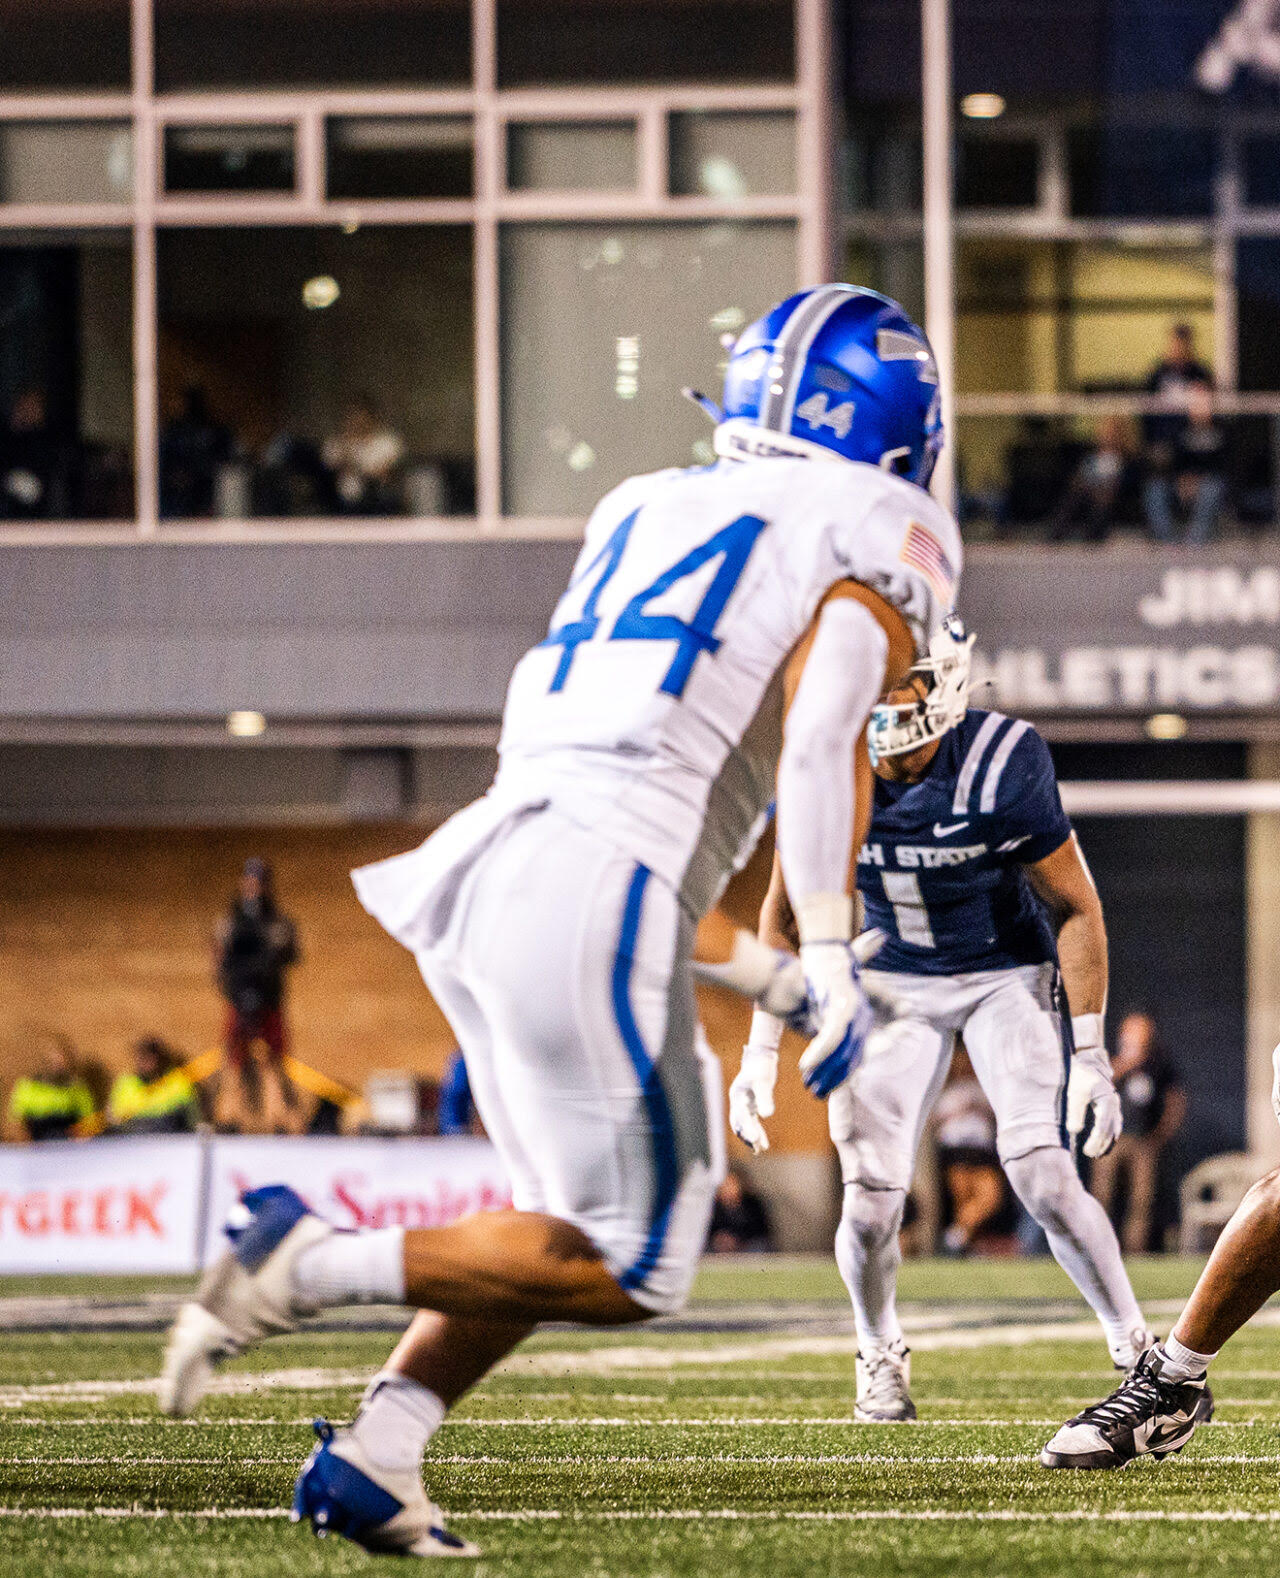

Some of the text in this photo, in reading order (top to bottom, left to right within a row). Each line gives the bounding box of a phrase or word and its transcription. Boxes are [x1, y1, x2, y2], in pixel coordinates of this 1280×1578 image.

[797, 391, 855, 440] 44
[536, 504, 769, 699] 44
[881, 872, 936, 949] 1
